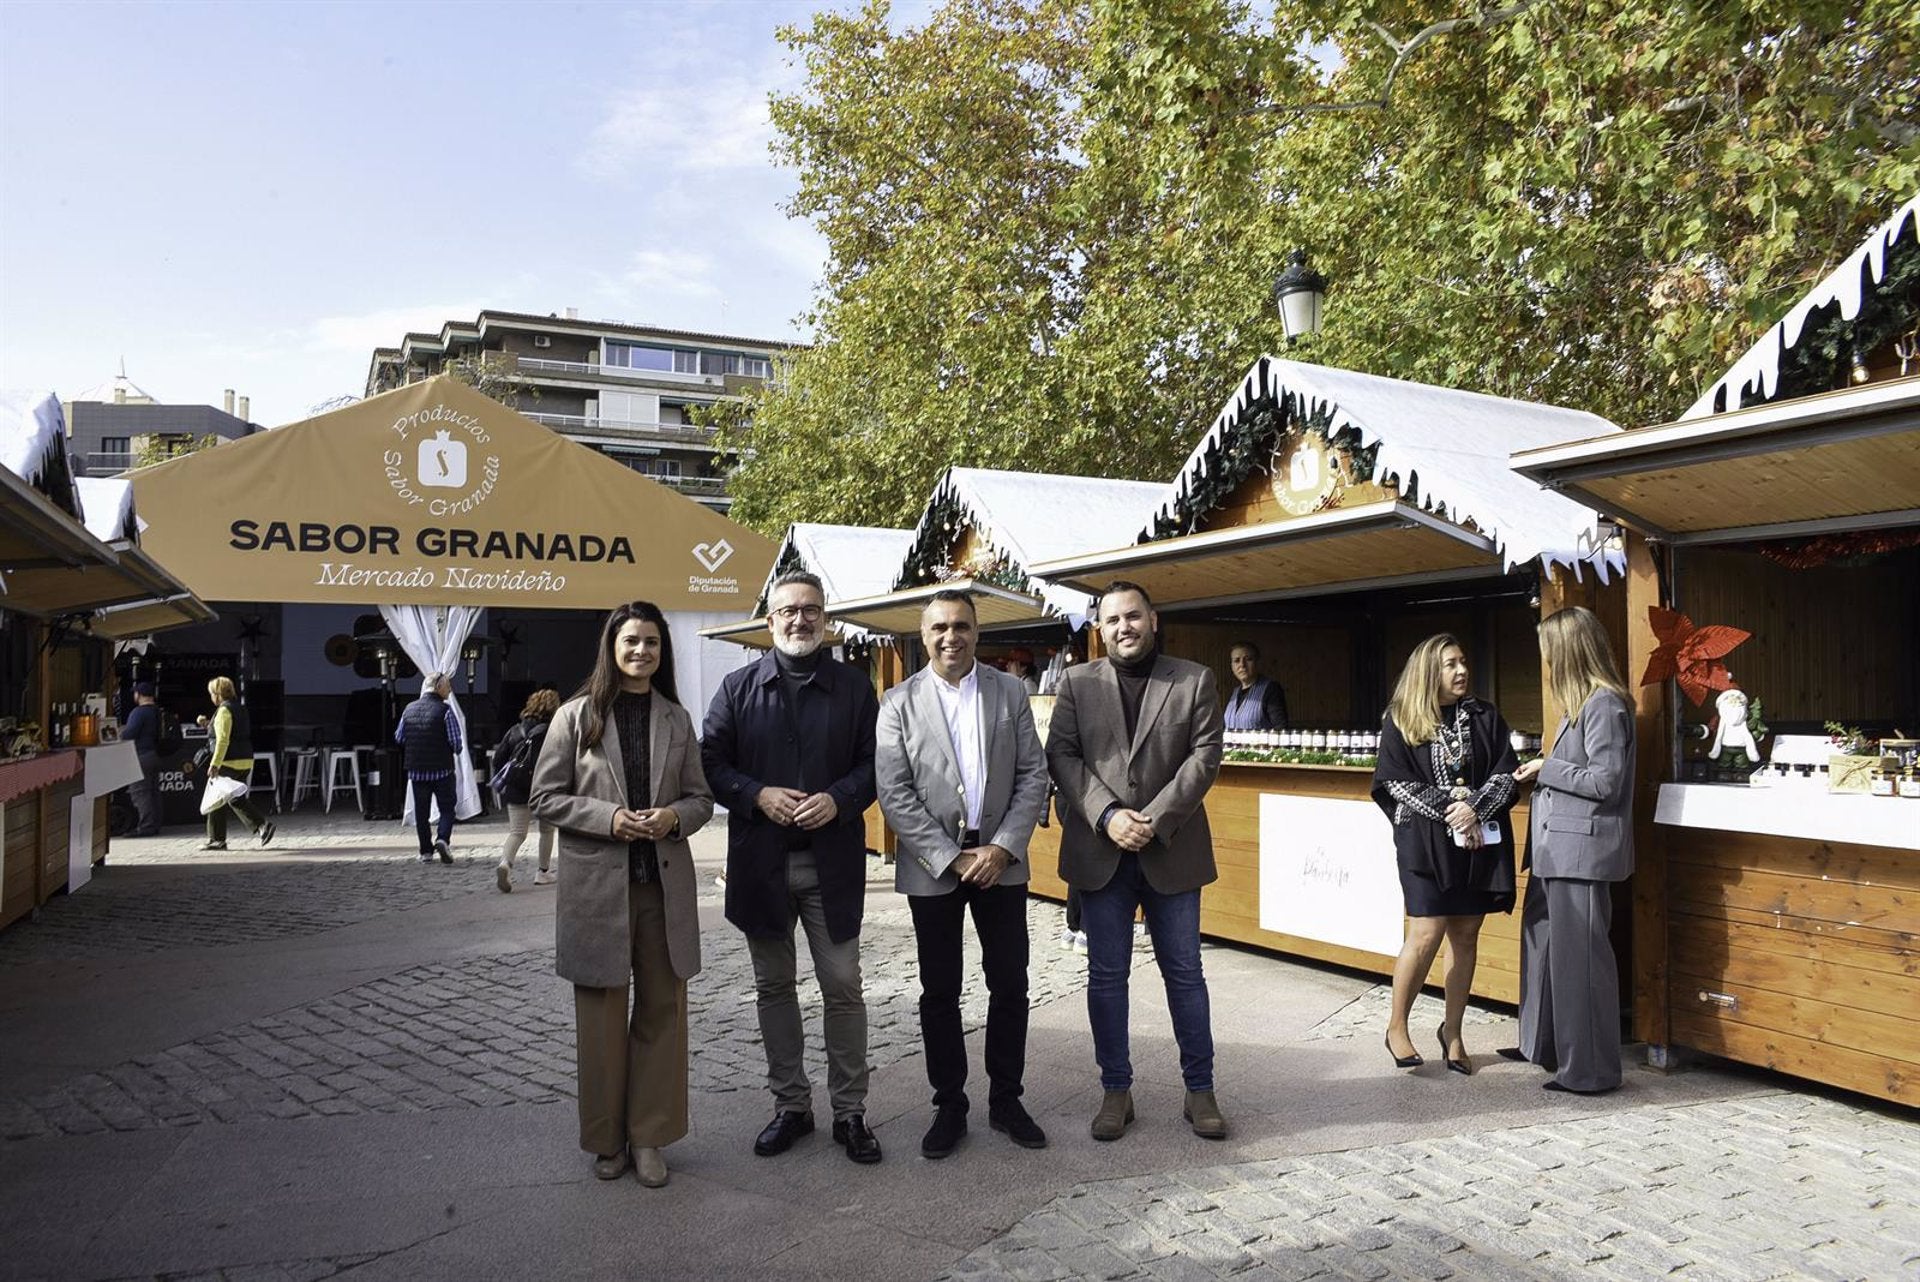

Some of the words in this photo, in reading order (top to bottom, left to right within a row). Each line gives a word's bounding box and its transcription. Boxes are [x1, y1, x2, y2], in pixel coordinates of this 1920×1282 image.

[392, 404, 490, 443] Productos
[383, 449, 424, 505] Sabor
[429, 455, 500, 517] Granada
[229, 519, 400, 555] SABOR
[416, 527, 636, 565] GRANADA
[313, 562, 435, 588] Mercado
[441, 567, 566, 592] Navideño
[688, 584, 700, 593] de
[701, 584, 739, 594] Granada
[689, 575, 738, 585] Diputación
